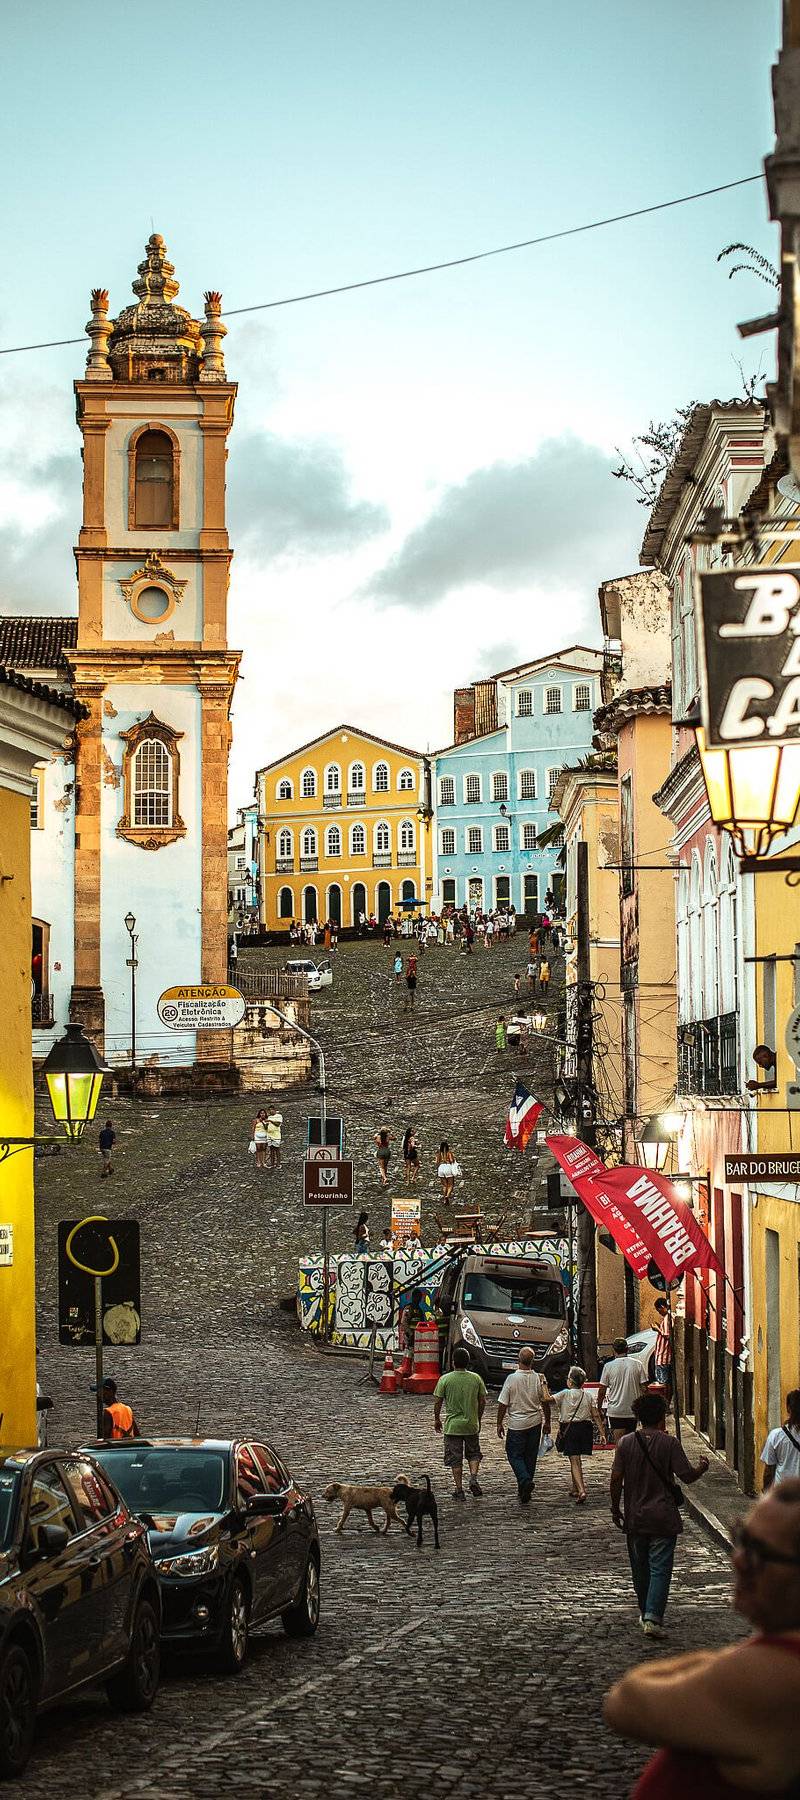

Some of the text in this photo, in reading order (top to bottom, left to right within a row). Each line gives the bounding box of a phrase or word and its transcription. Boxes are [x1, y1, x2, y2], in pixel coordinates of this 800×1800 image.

[718, 573, 800, 638] B
[178, 987, 226, 997] ATENÇÃO
[178, 1000, 226, 1009] Fiscalização
[181, 1008, 222, 1016] Eletrônica
[726, 1162, 748, 1176] BAR
[750, 1161, 767, 1175] DO
[625, 1174, 697, 1267] BRAHMA
